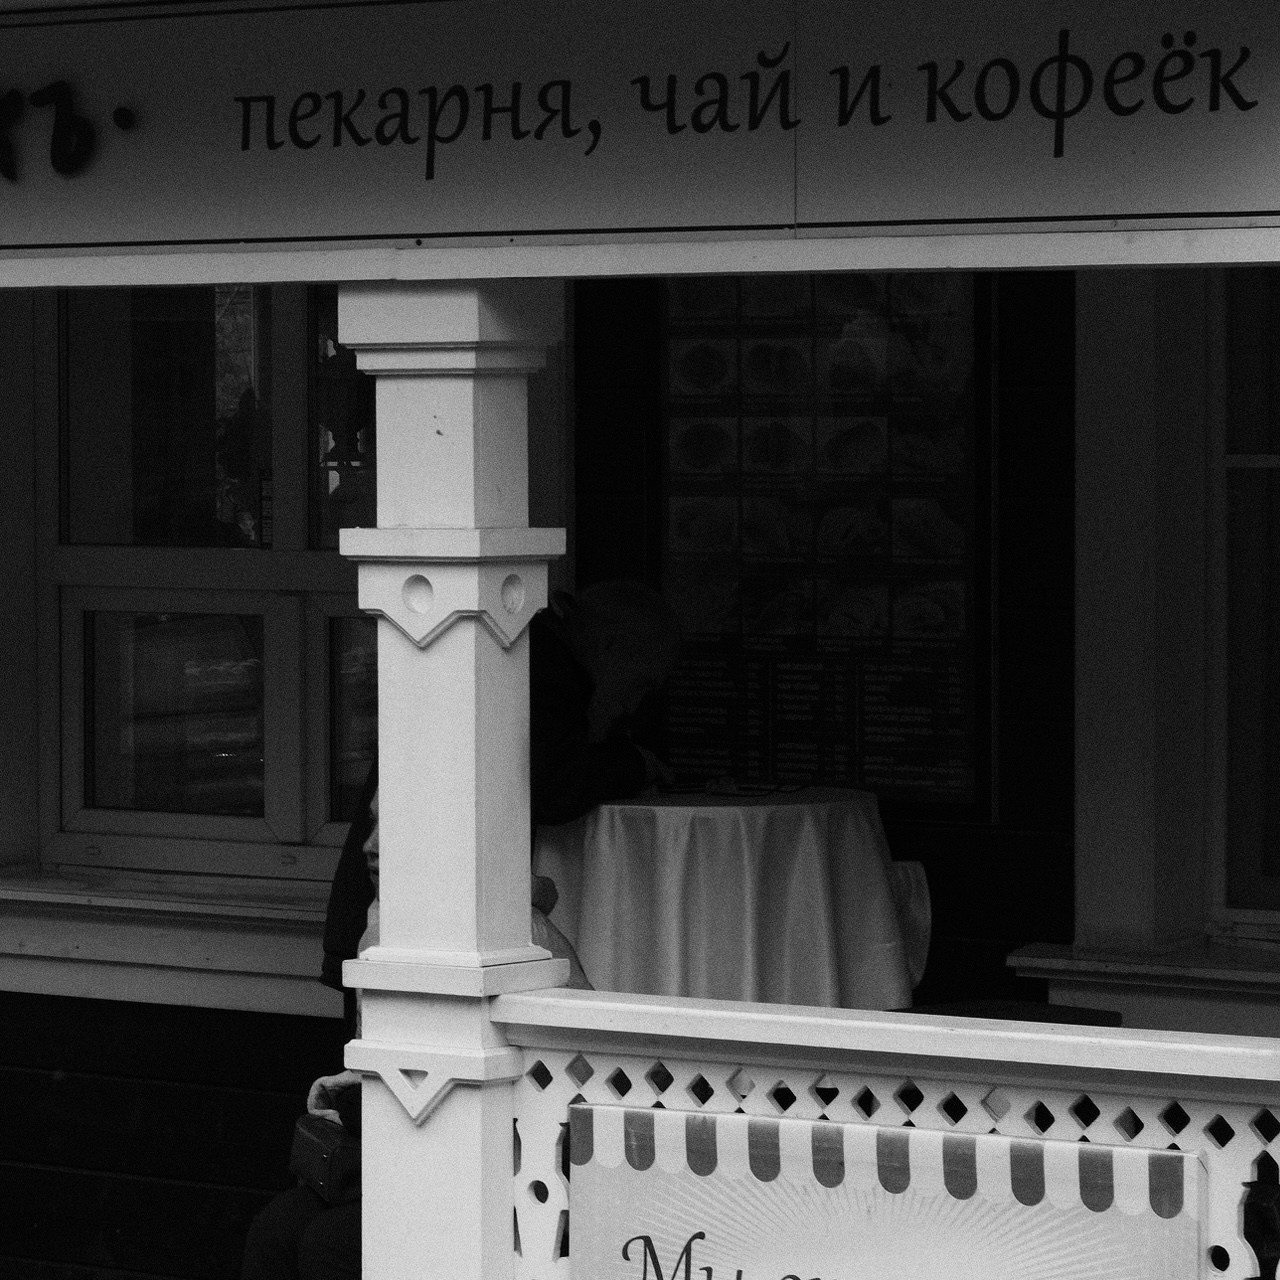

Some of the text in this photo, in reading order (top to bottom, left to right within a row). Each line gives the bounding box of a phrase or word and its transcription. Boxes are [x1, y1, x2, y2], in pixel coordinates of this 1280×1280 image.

[233, 28, 1259, 181] пекарня, чай и кофеёк
